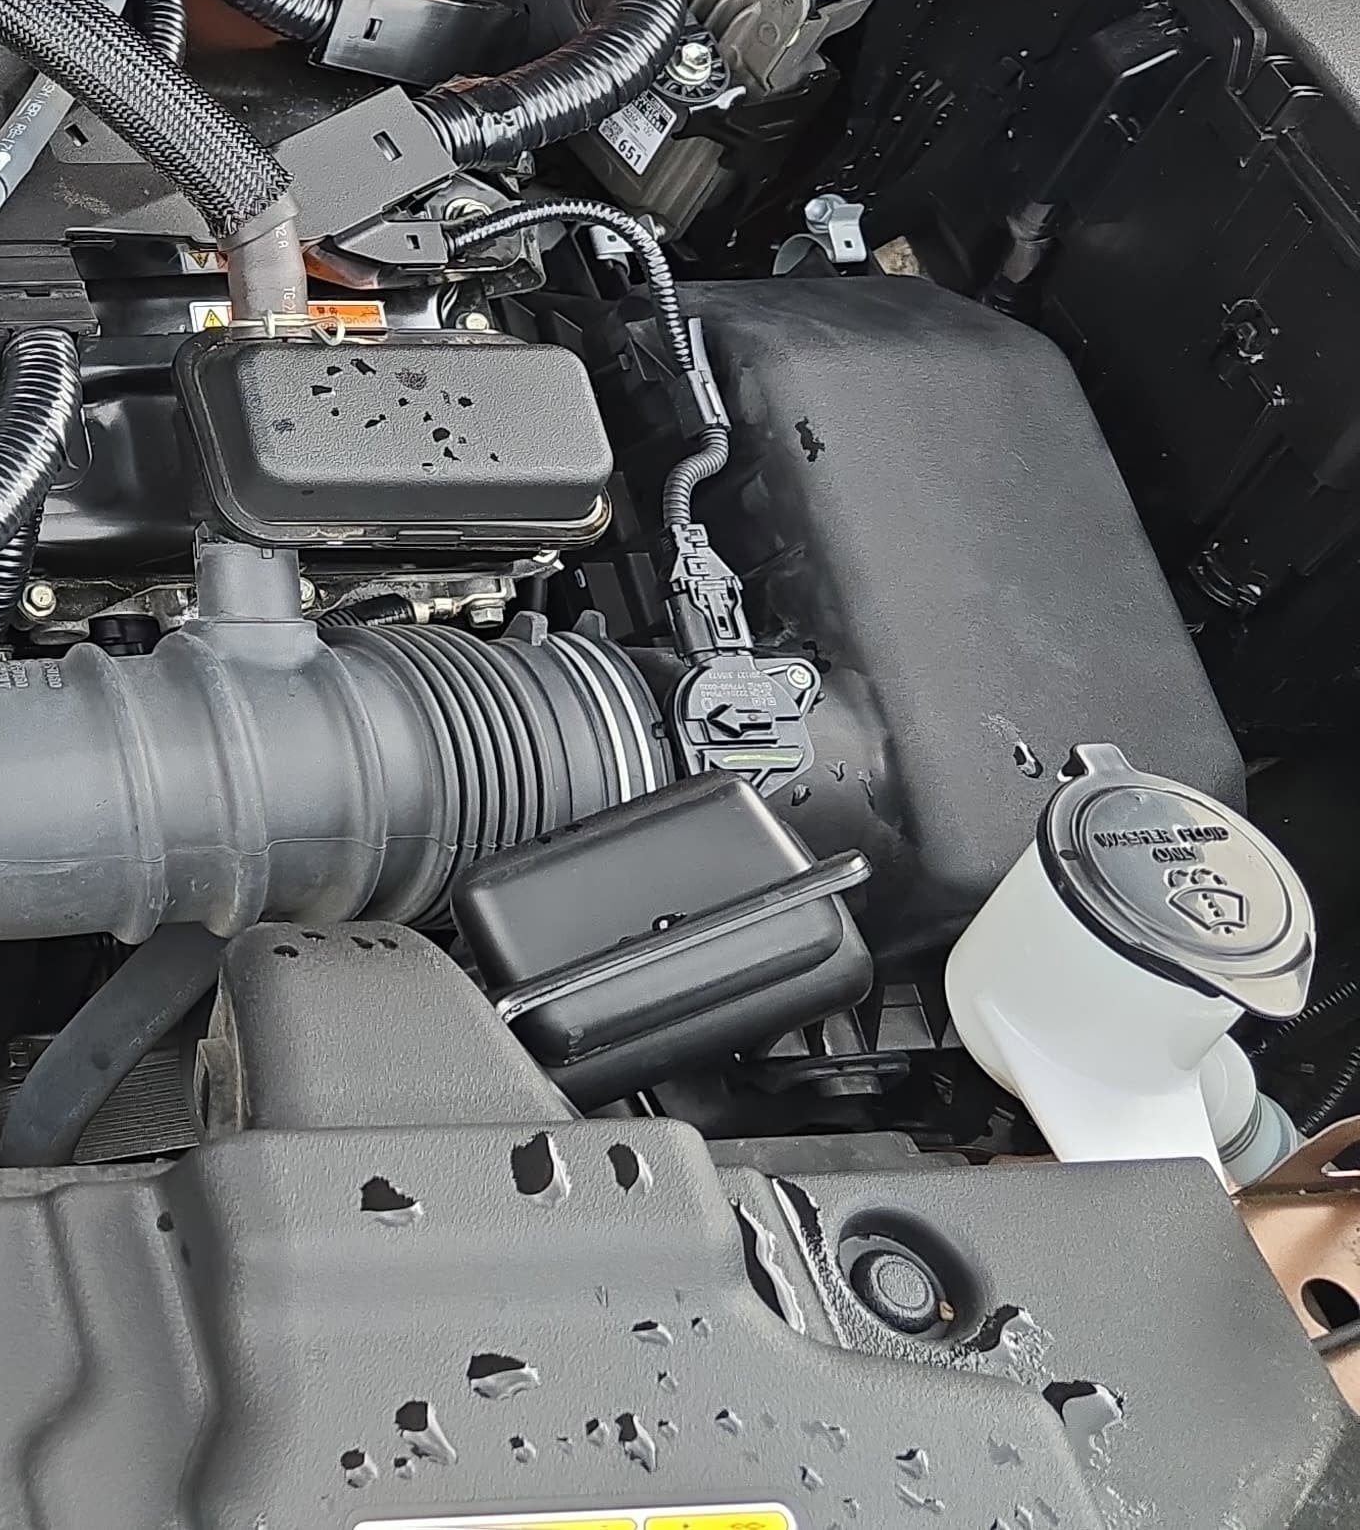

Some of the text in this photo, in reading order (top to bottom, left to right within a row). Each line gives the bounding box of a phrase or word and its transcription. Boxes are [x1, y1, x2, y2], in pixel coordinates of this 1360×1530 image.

[618, 139, 642, 167] 651
[1093, 825, 1229, 848] WASHER FLUID
[1152, 845, 1199, 863] ONLY
